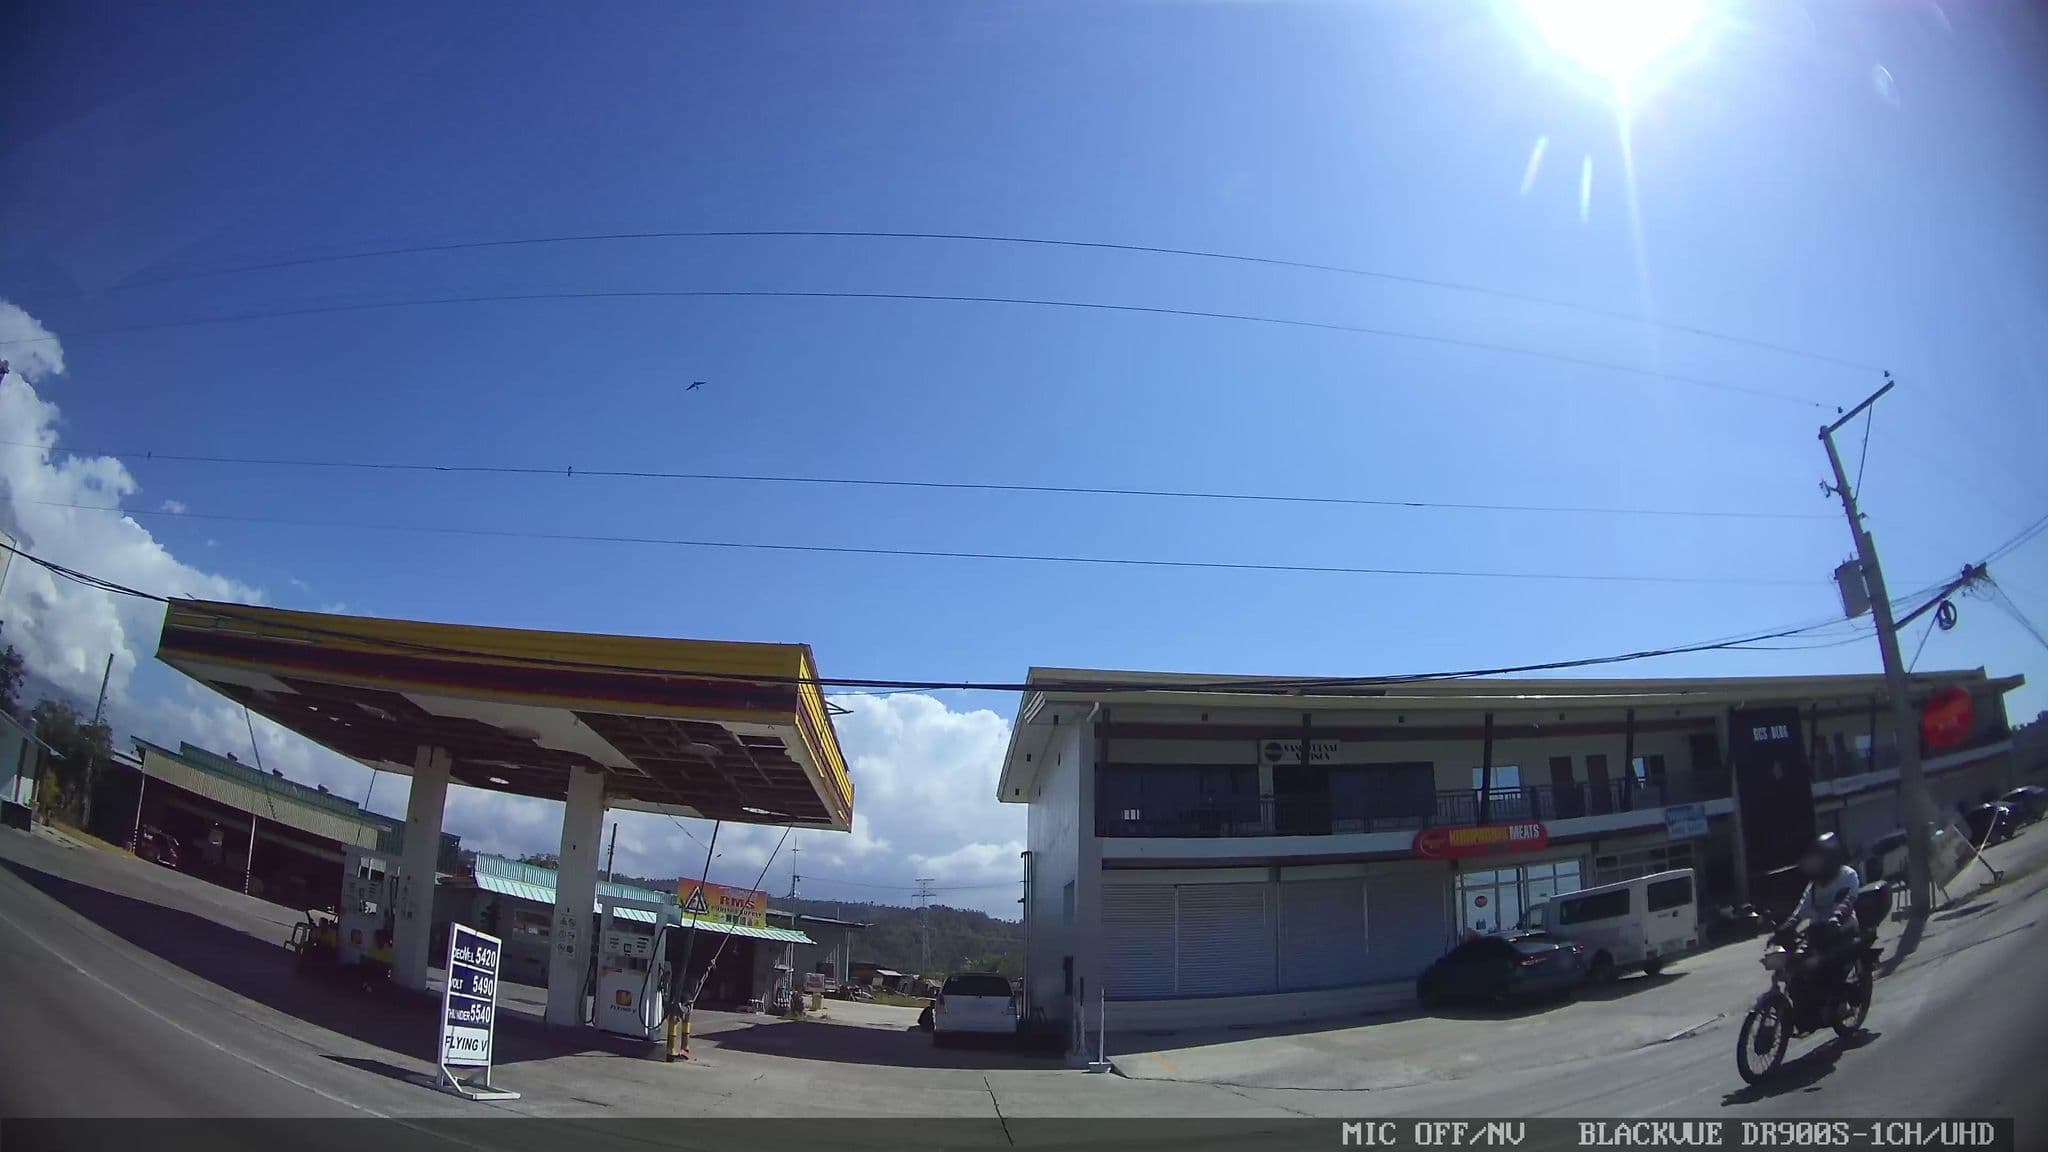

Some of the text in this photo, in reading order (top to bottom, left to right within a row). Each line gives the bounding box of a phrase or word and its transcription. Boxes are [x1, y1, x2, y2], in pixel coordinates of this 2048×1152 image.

[1509, 824, 1540, 840] MEATS
[475, 947, 496, 968] 5420
[472, 975, 493, 996] 5490
[470, 1004, 491, 1024] 5540
[445, 1035, 489, 1052] FLYING V
